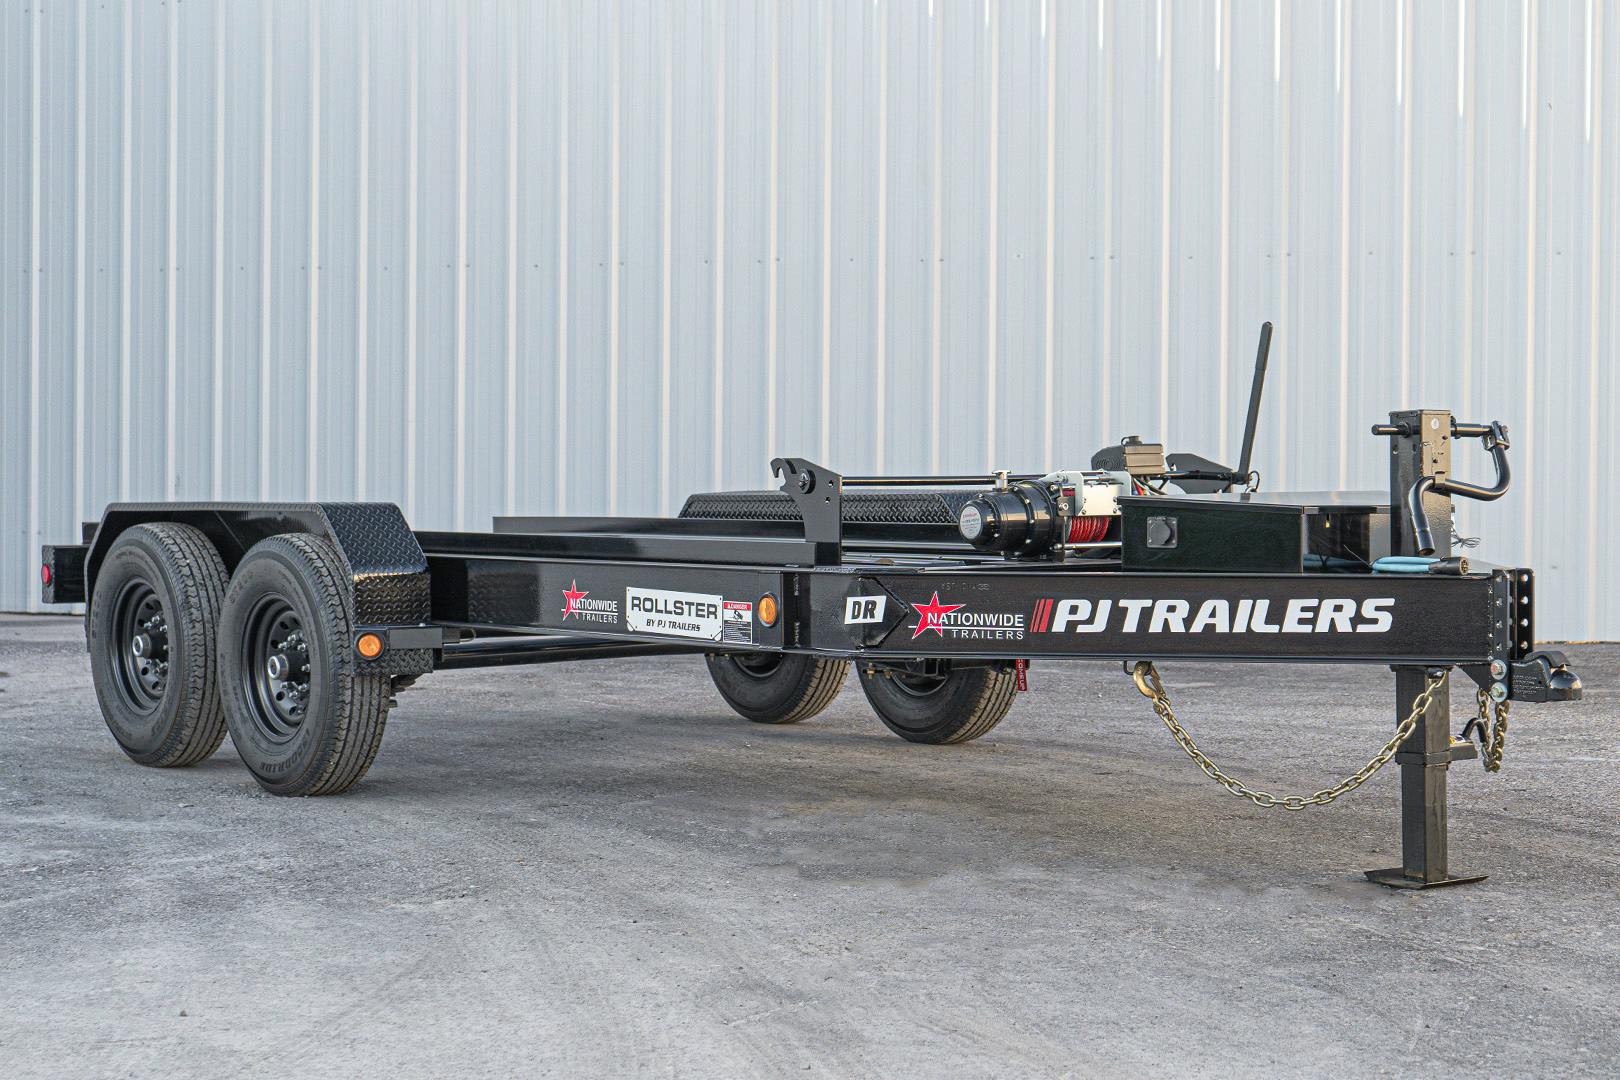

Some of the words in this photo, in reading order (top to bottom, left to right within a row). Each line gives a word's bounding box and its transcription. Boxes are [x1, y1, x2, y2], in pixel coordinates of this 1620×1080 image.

[570, 598, 618, 611] NATIONWIDE
[631, 596, 718, 619] ROLLSTER
[851, 600, 877, 620] DR
[582, 612, 618, 624] TRAILERS
[927, 612, 1024, 627] NATIONWIDE
[1052, 599, 1112, 633] PJ
[1118, 598, 1395, 633] TRAILERS
[646, 618, 656, 627] BY
[657, 619, 666, 629] PJ
[668, 620, 701, 632] TRAILERS
[952, 629, 1024, 640] TRAILERS
